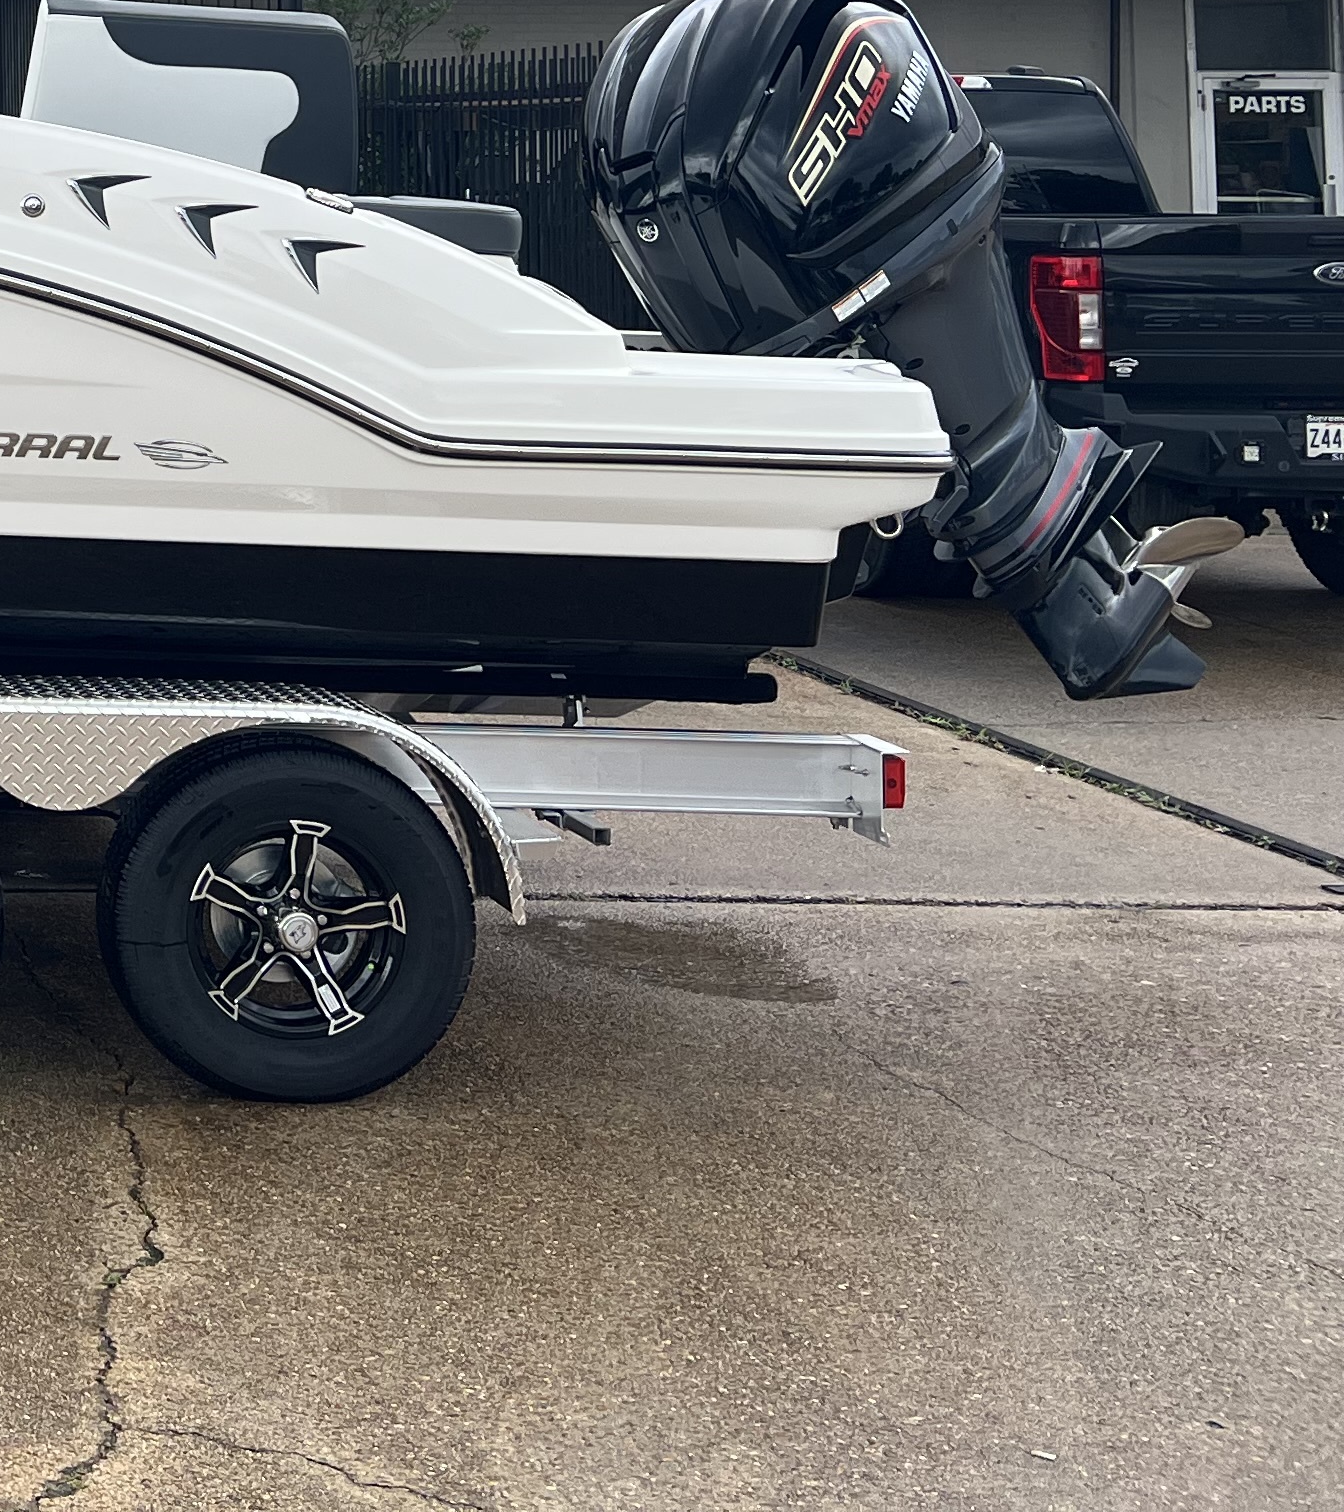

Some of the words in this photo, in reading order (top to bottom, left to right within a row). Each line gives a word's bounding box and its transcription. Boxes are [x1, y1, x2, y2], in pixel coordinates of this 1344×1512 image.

[891, 50, 930, 123] YAMAHA
[1228, 95, 1307, 114] PARTS
[788, 40, 883, 207] SHO
